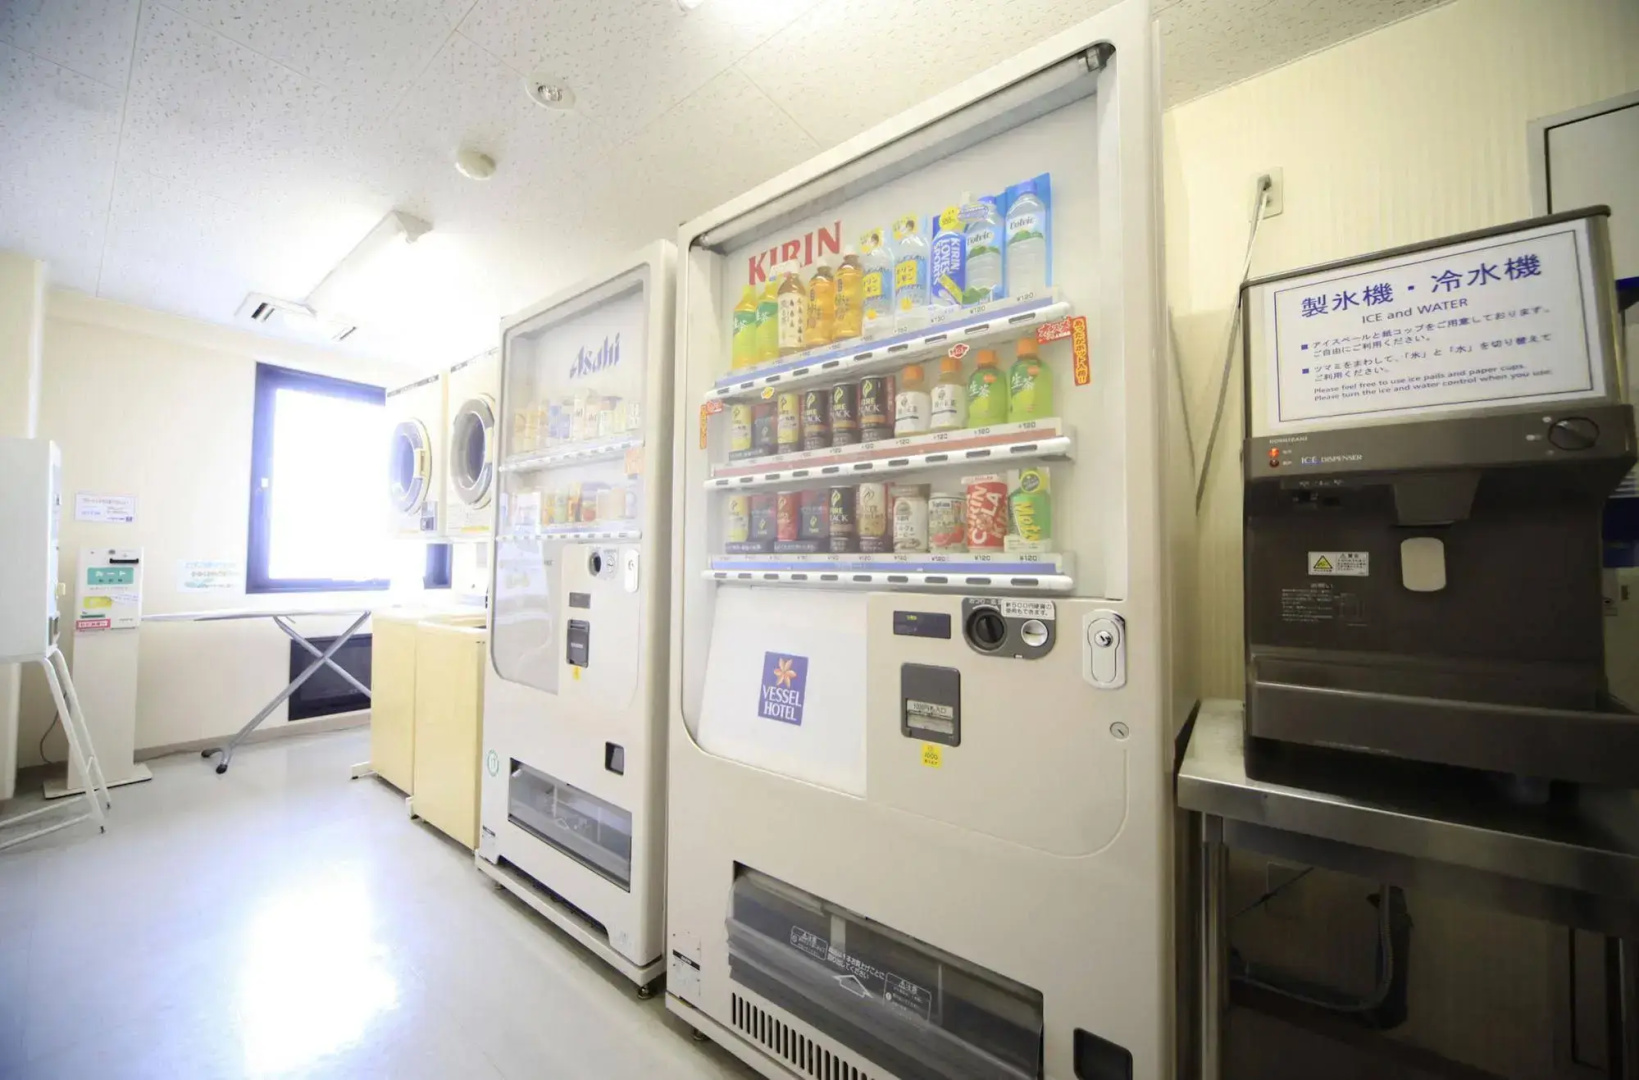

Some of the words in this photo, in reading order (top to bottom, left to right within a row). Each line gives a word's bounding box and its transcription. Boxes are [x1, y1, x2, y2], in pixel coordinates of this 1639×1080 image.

[748, 219, 841, 286] KIRIN
[950, 237, 961, 270] KIRIN
[1301, 253, 1542, 318] 製氷機・冷水機
[1362, 312, 1383, 324] ICE
[1387, 308, 1413, 320] and
[1417, 298, 1468, 315] WATER
[569, 332, 620, 379] Asahi
[1314, 386, 1340, 394] Please
[1341, 383, 1357, 391] feel
[1447, 369, 1466, 378] and
[1469, 367, 1498, 376] paper
[1314, 394, 1340, 402] Please
[1342, 390, 1360, 398] turn
[1412, 381, 1440, 389] water
[1442, 376, 1477, 387] control
[1479, 373, 1508, 382] when
[1510, 371, 1530, 380] you
[1301, 455, 1318, 465] ICE
[1321, 454, 1363, 463] DISPENSER
[762, 684, 802, 707] VESSEL
[763, 700, 798, 721] HOTEL
